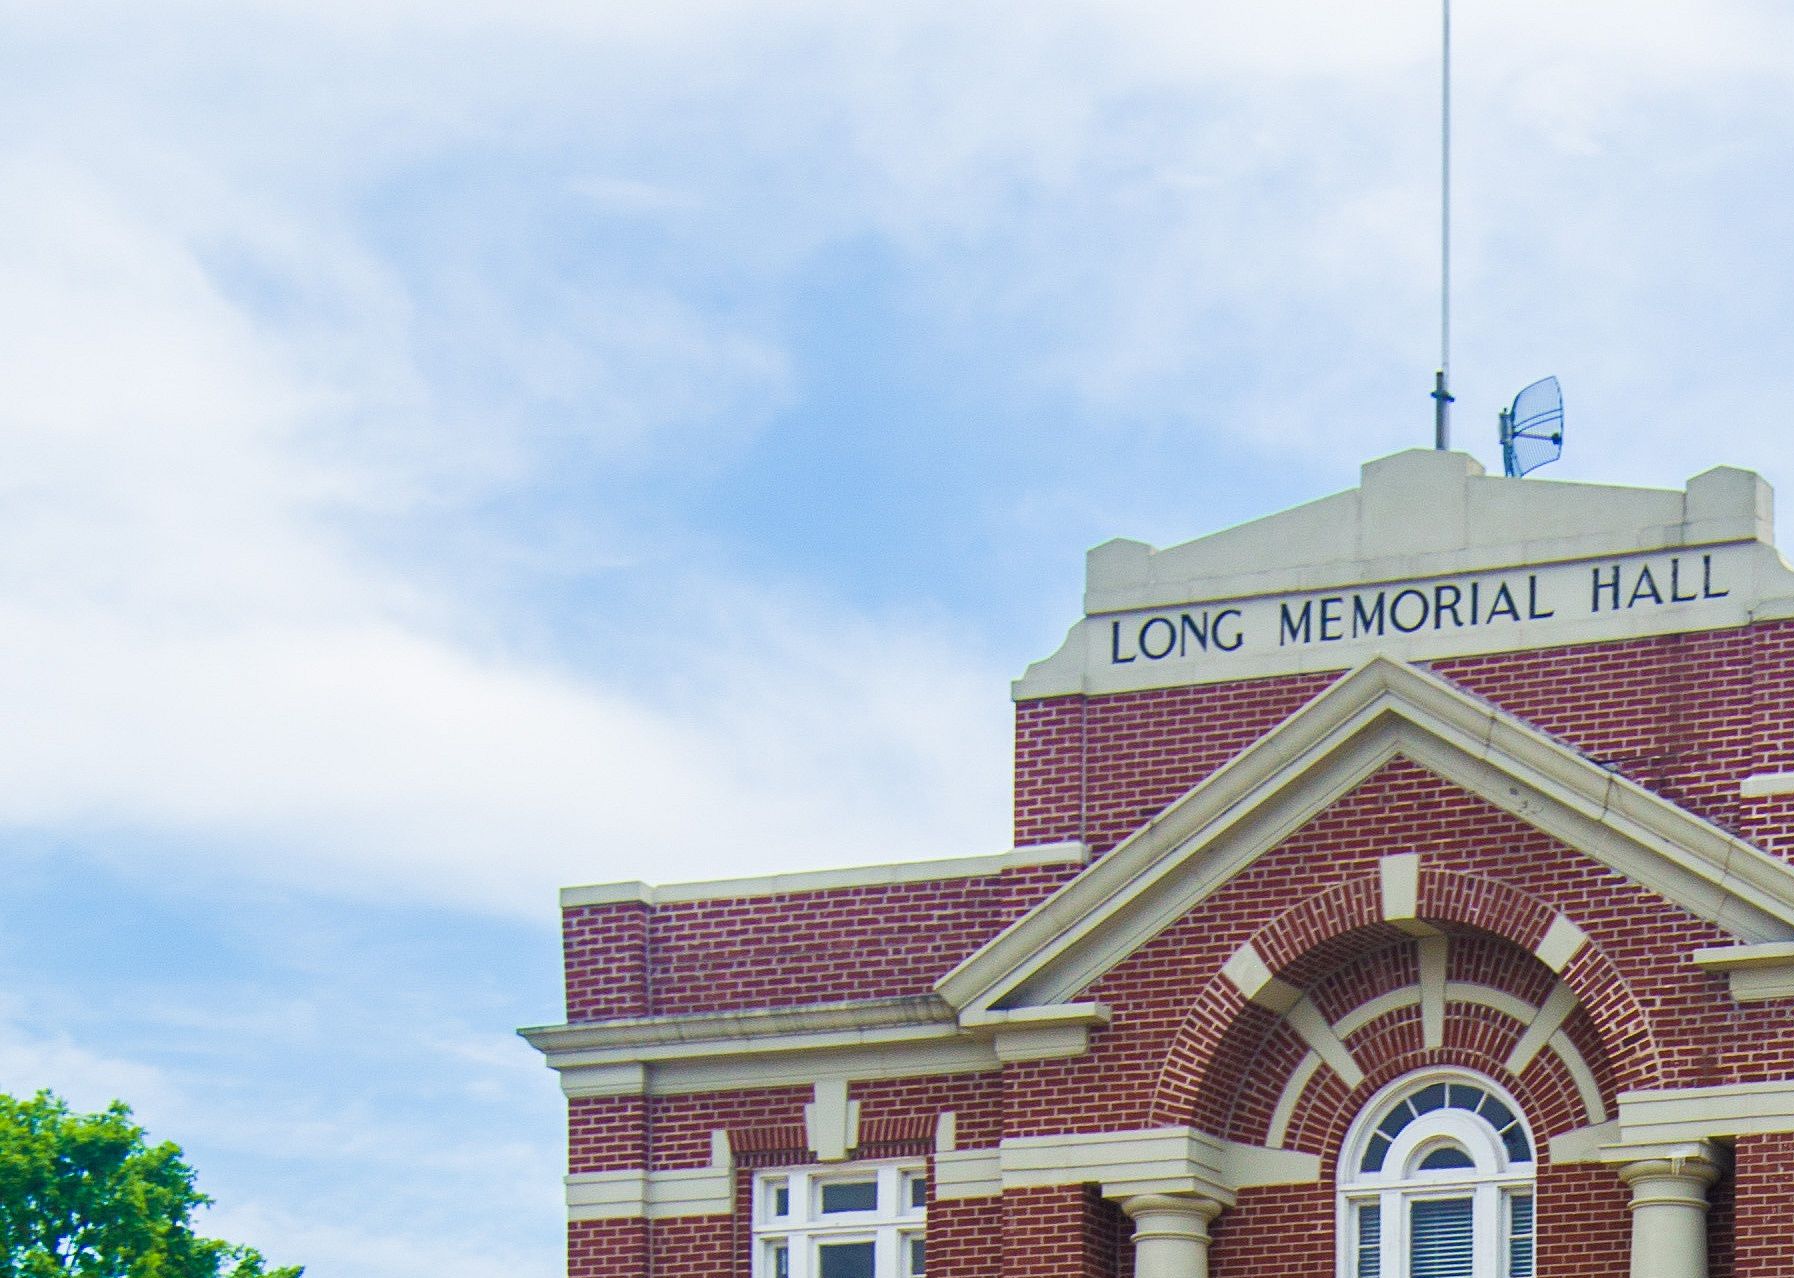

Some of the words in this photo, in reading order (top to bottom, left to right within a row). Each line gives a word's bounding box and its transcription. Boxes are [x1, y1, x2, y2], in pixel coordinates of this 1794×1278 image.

[1111, 609, 1244, 665] LONG
[1278, 574, 1555, 647] MEMORIAL
[1591, 554, 1730, 613] HALL
